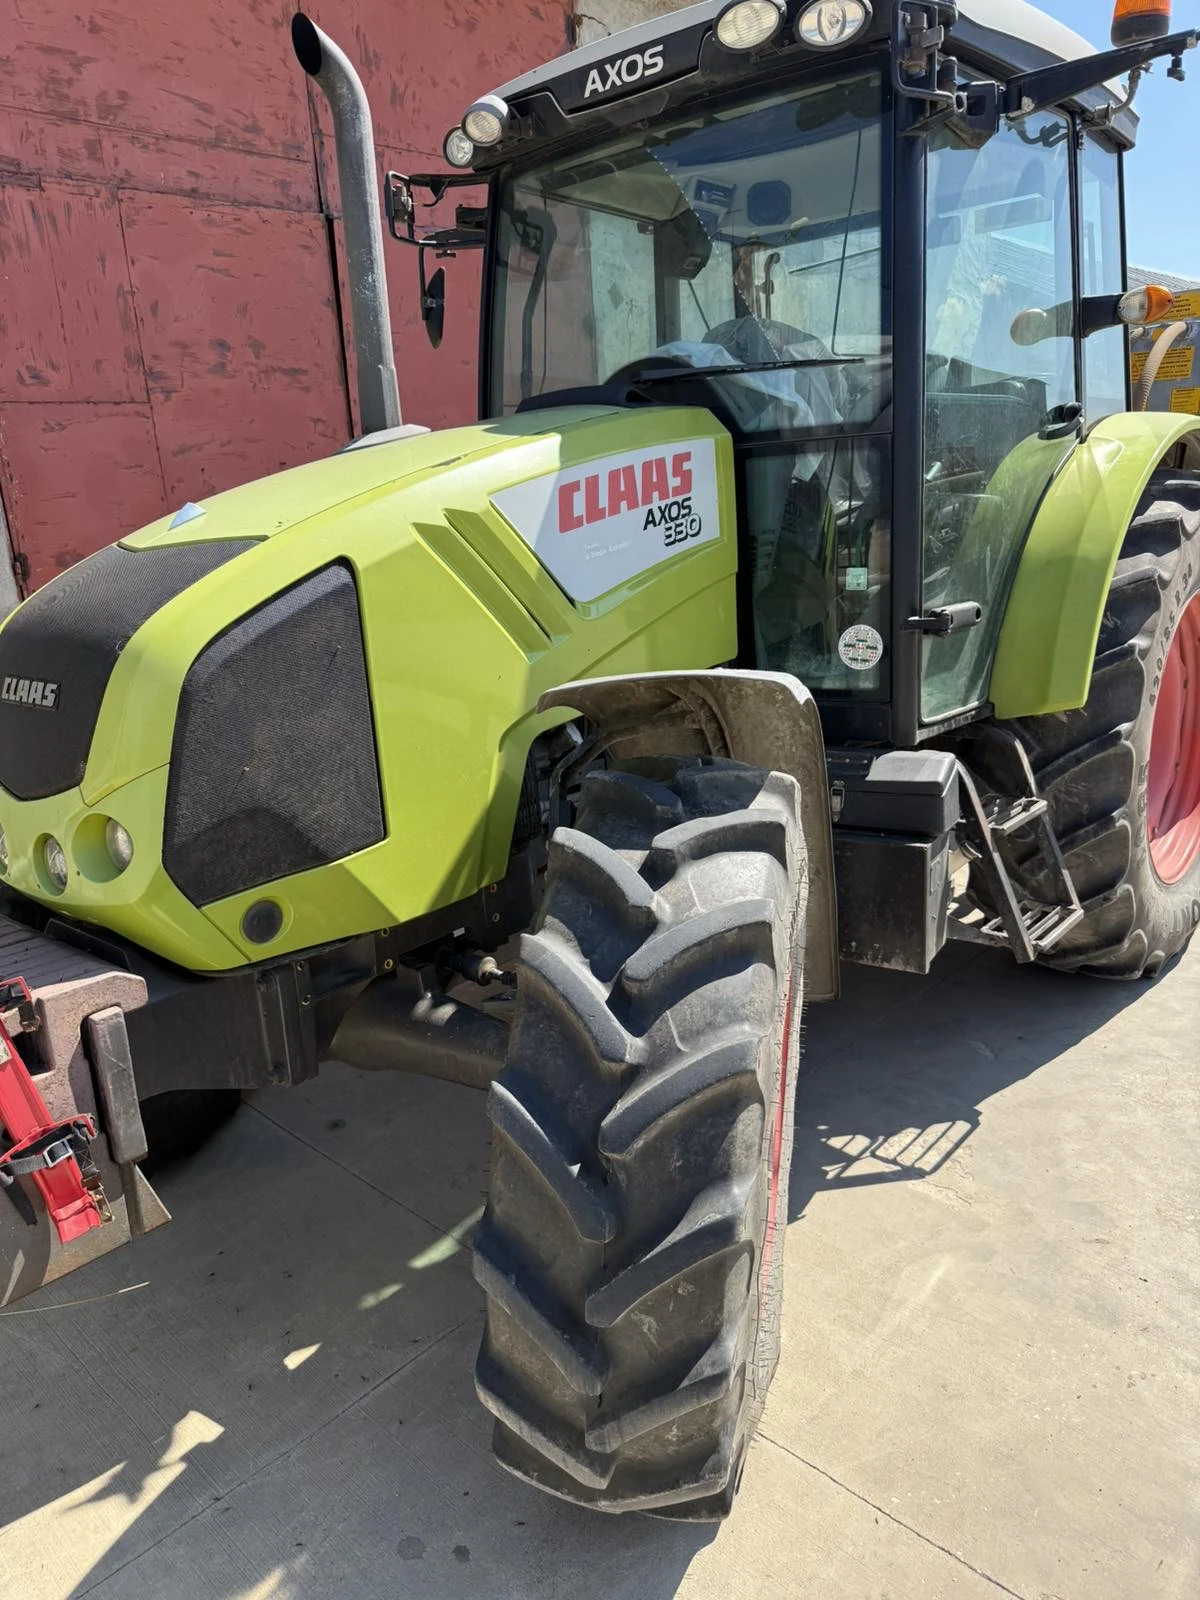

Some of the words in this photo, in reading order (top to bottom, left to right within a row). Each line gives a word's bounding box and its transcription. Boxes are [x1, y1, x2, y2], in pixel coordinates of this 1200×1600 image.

[583, 44, 664, 98] AXOS
[558, 451, 693, 534] CLAAS
[643, 496, 692, 531] AXOS
[664, 513, 702, 547] 330
[1, 677, 58, 707] CLAAS
